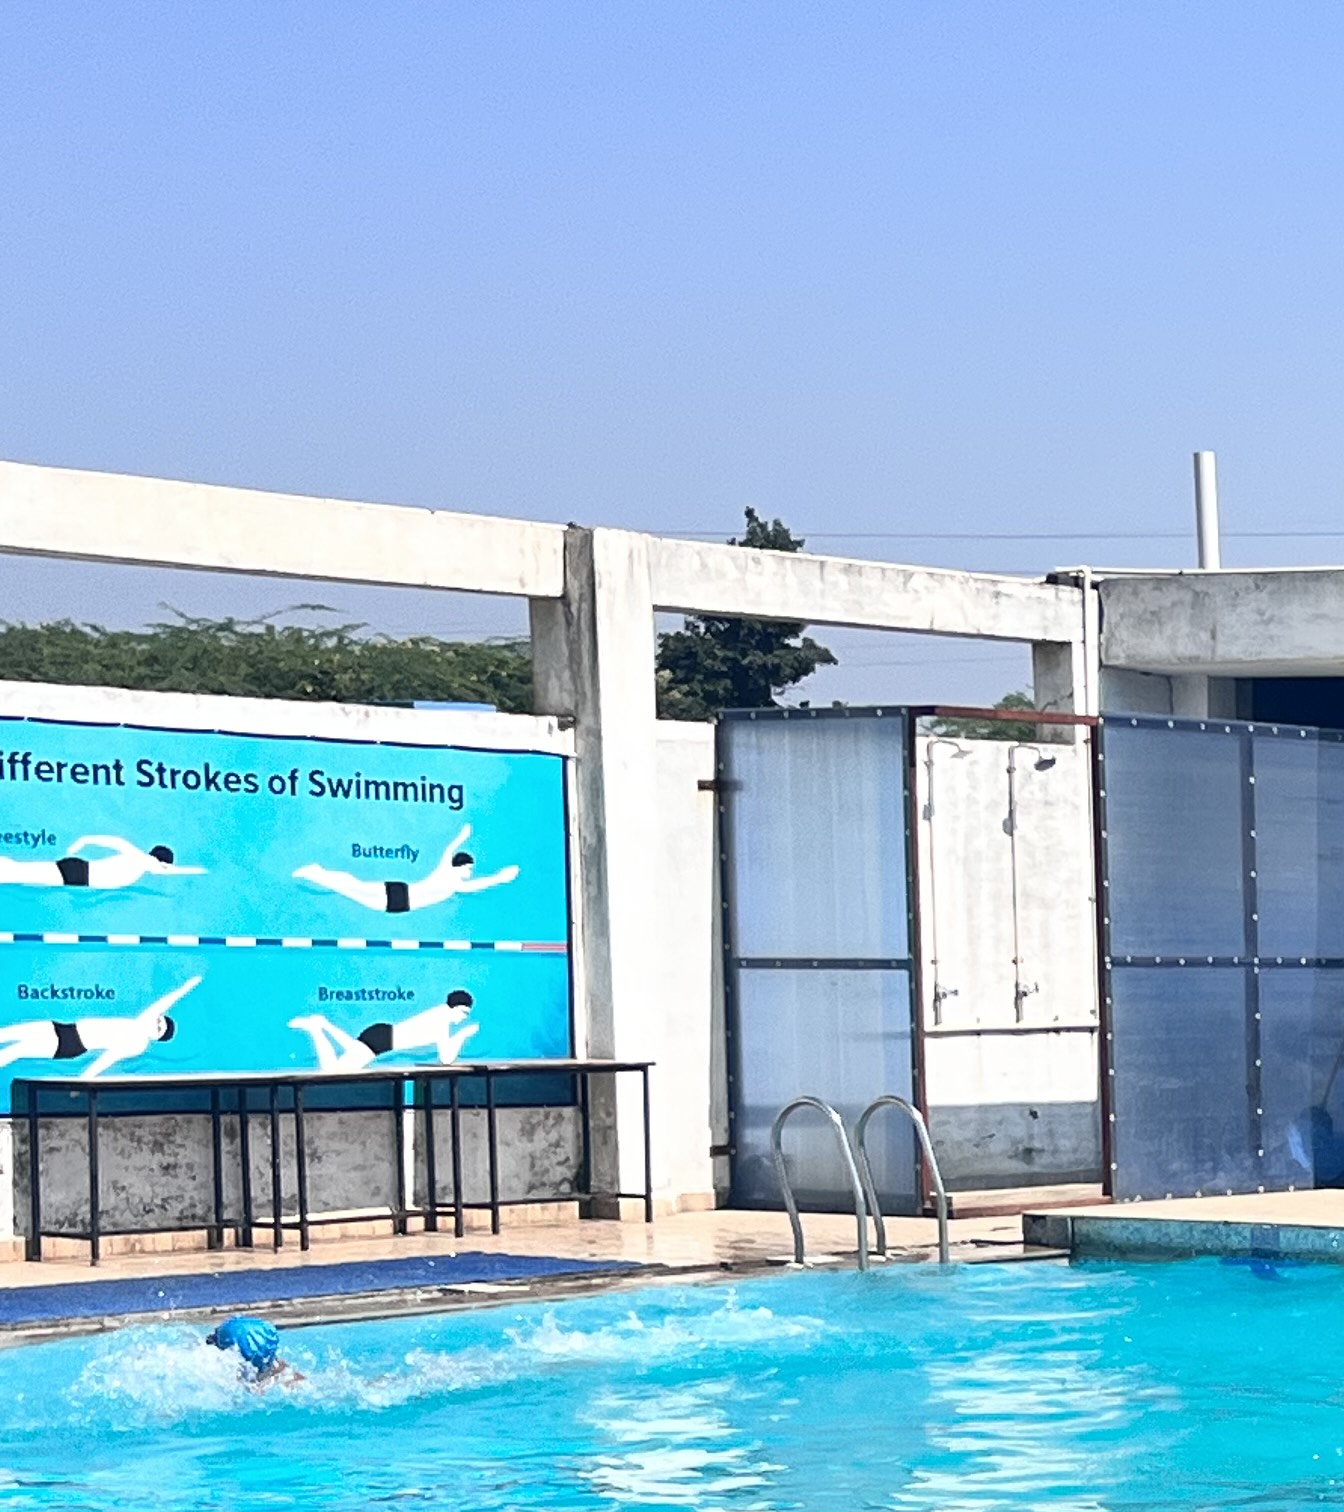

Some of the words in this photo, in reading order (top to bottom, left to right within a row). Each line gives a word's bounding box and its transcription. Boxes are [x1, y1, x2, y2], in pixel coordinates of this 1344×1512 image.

[136, 758, 260, 794] Strokes
[267, 767, 299, 797] of
[308, 769, 464, 812] Swimming
[351, 842, 420, 864] Butterfly
[17, 983, 115, 1000] Backstroke
[318, 986, 415, 1002] Breaststroke
